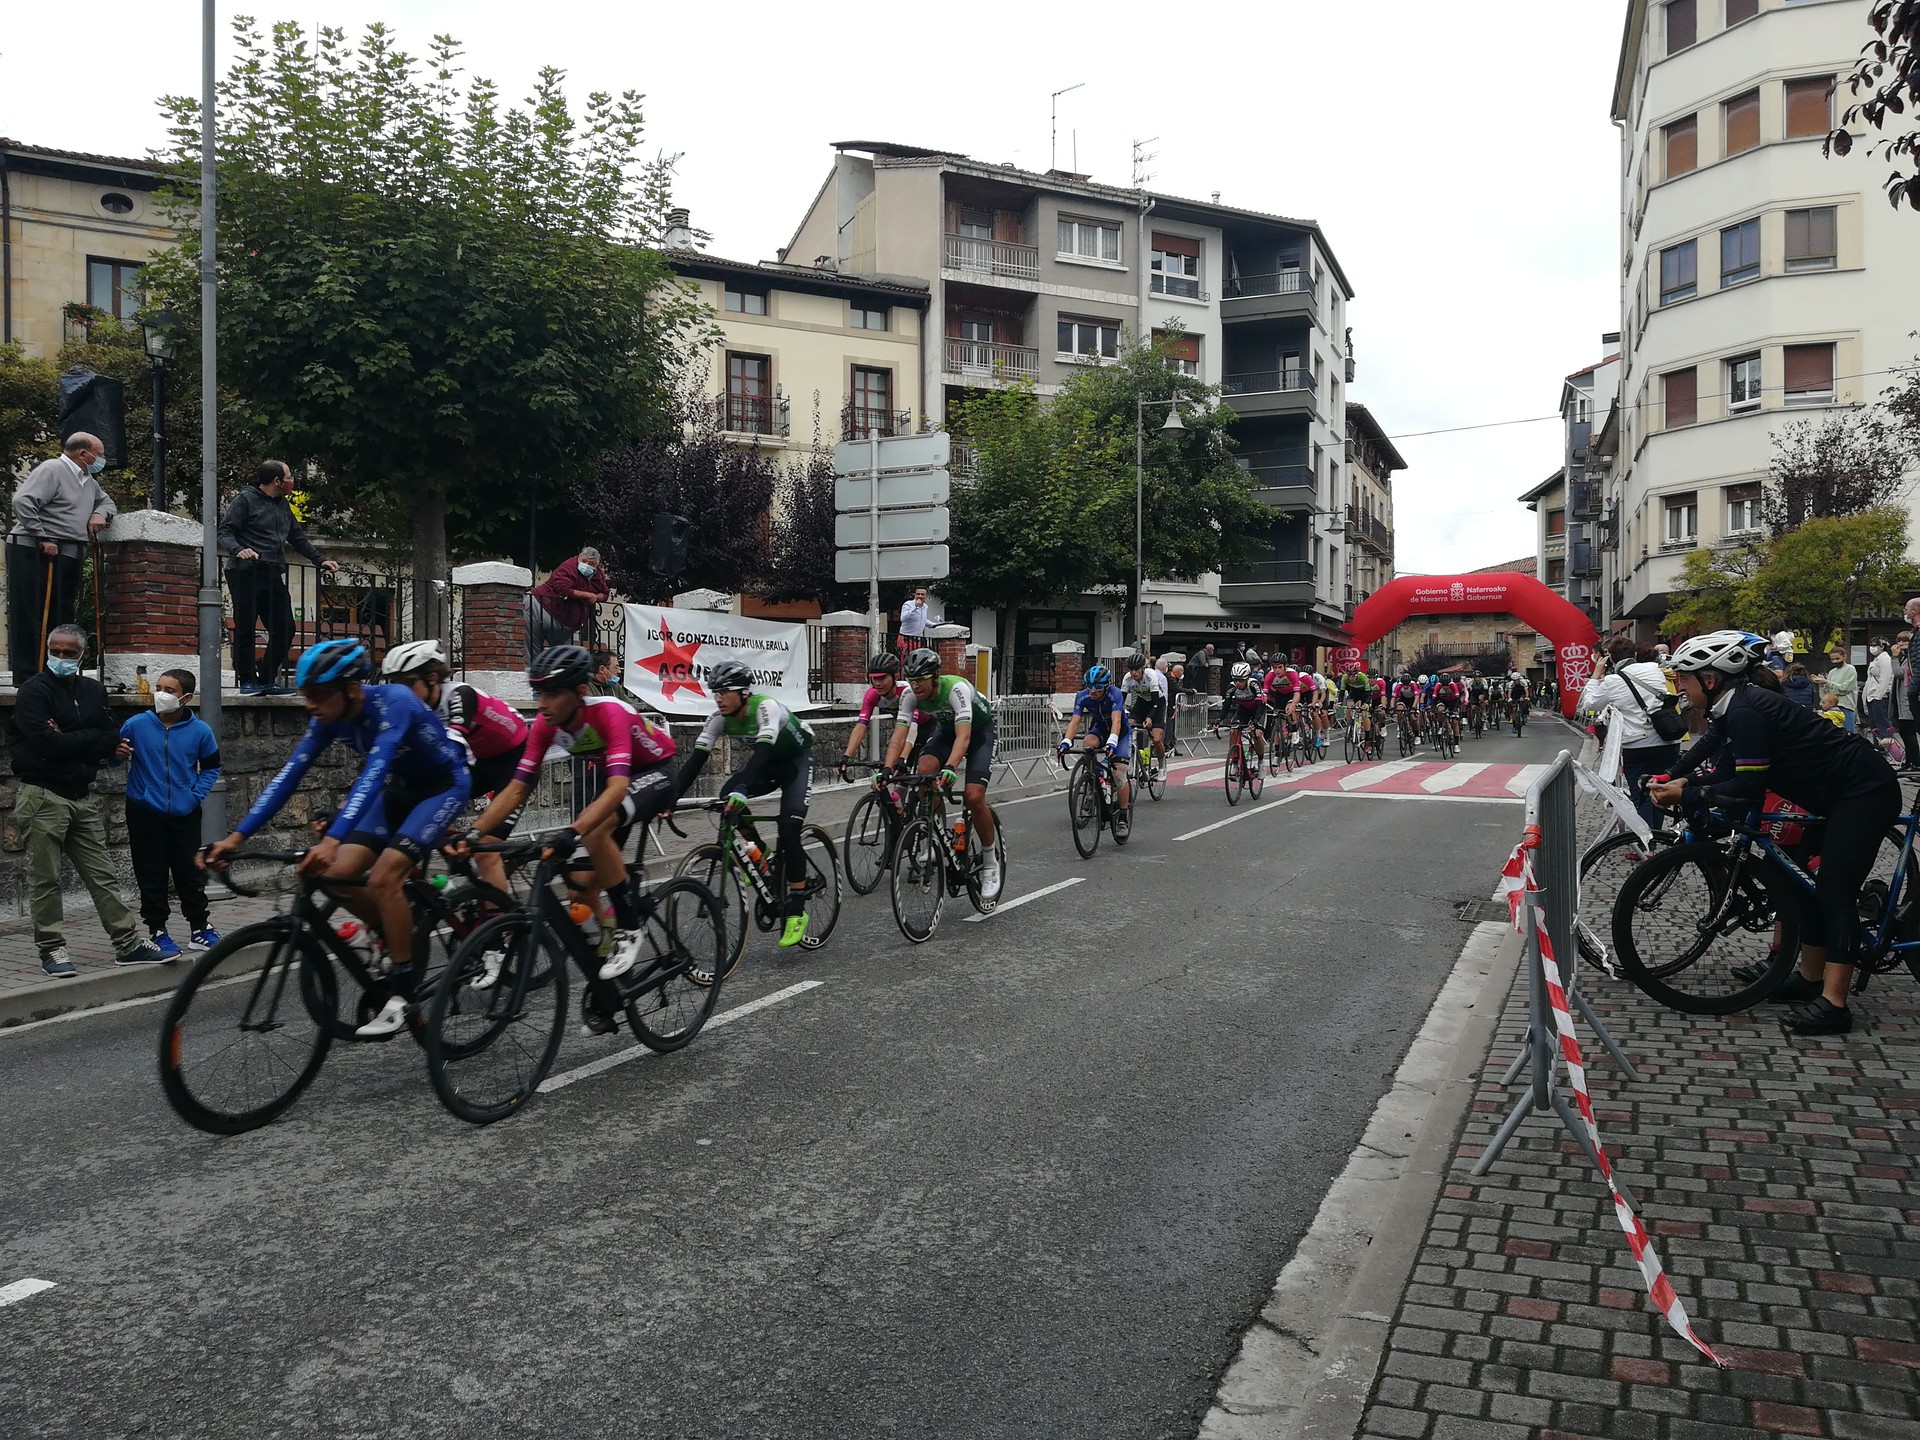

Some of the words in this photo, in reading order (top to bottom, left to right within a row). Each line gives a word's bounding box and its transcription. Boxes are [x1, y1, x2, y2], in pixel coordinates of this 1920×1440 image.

[1466, 585, 1507, 593] Nafarroako
[1420, 595, 1448, 603] Navarra
[1205, 620, 1250, 631] ASENSIO
[647, 629, 673, 641] IGOR
[677, 632, 729, 646] GONZALEZ
[731, 636, 764, 650] ESTATUAK
[765, 640, 790, 652] ERAILA
